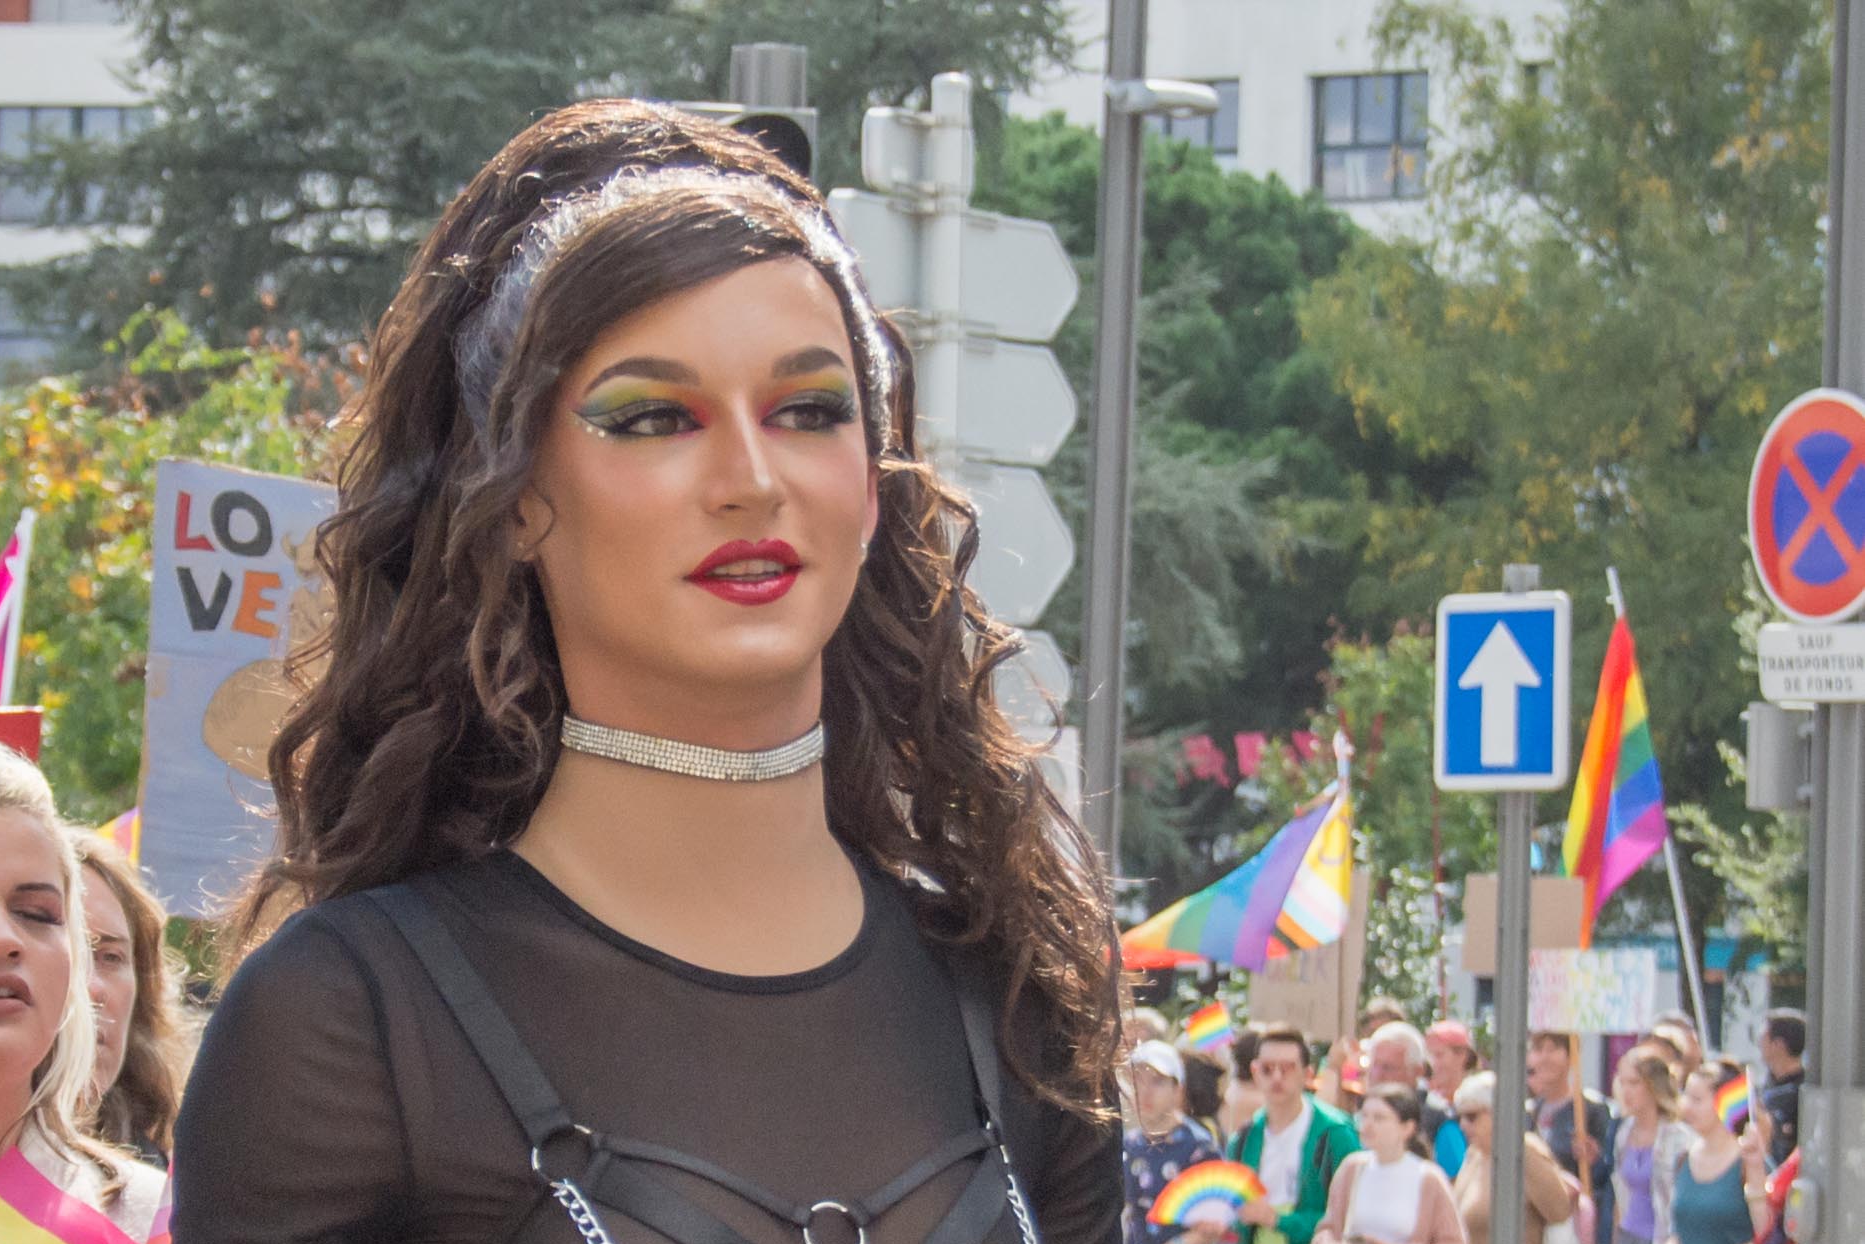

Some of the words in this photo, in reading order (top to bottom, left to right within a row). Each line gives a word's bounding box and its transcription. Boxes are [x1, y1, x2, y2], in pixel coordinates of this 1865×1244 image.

[1797, 634, 1833, 650] SAUF
[1784, 676, 1802, 693] DE
[1807, 676, 1853, 692] FONDS
